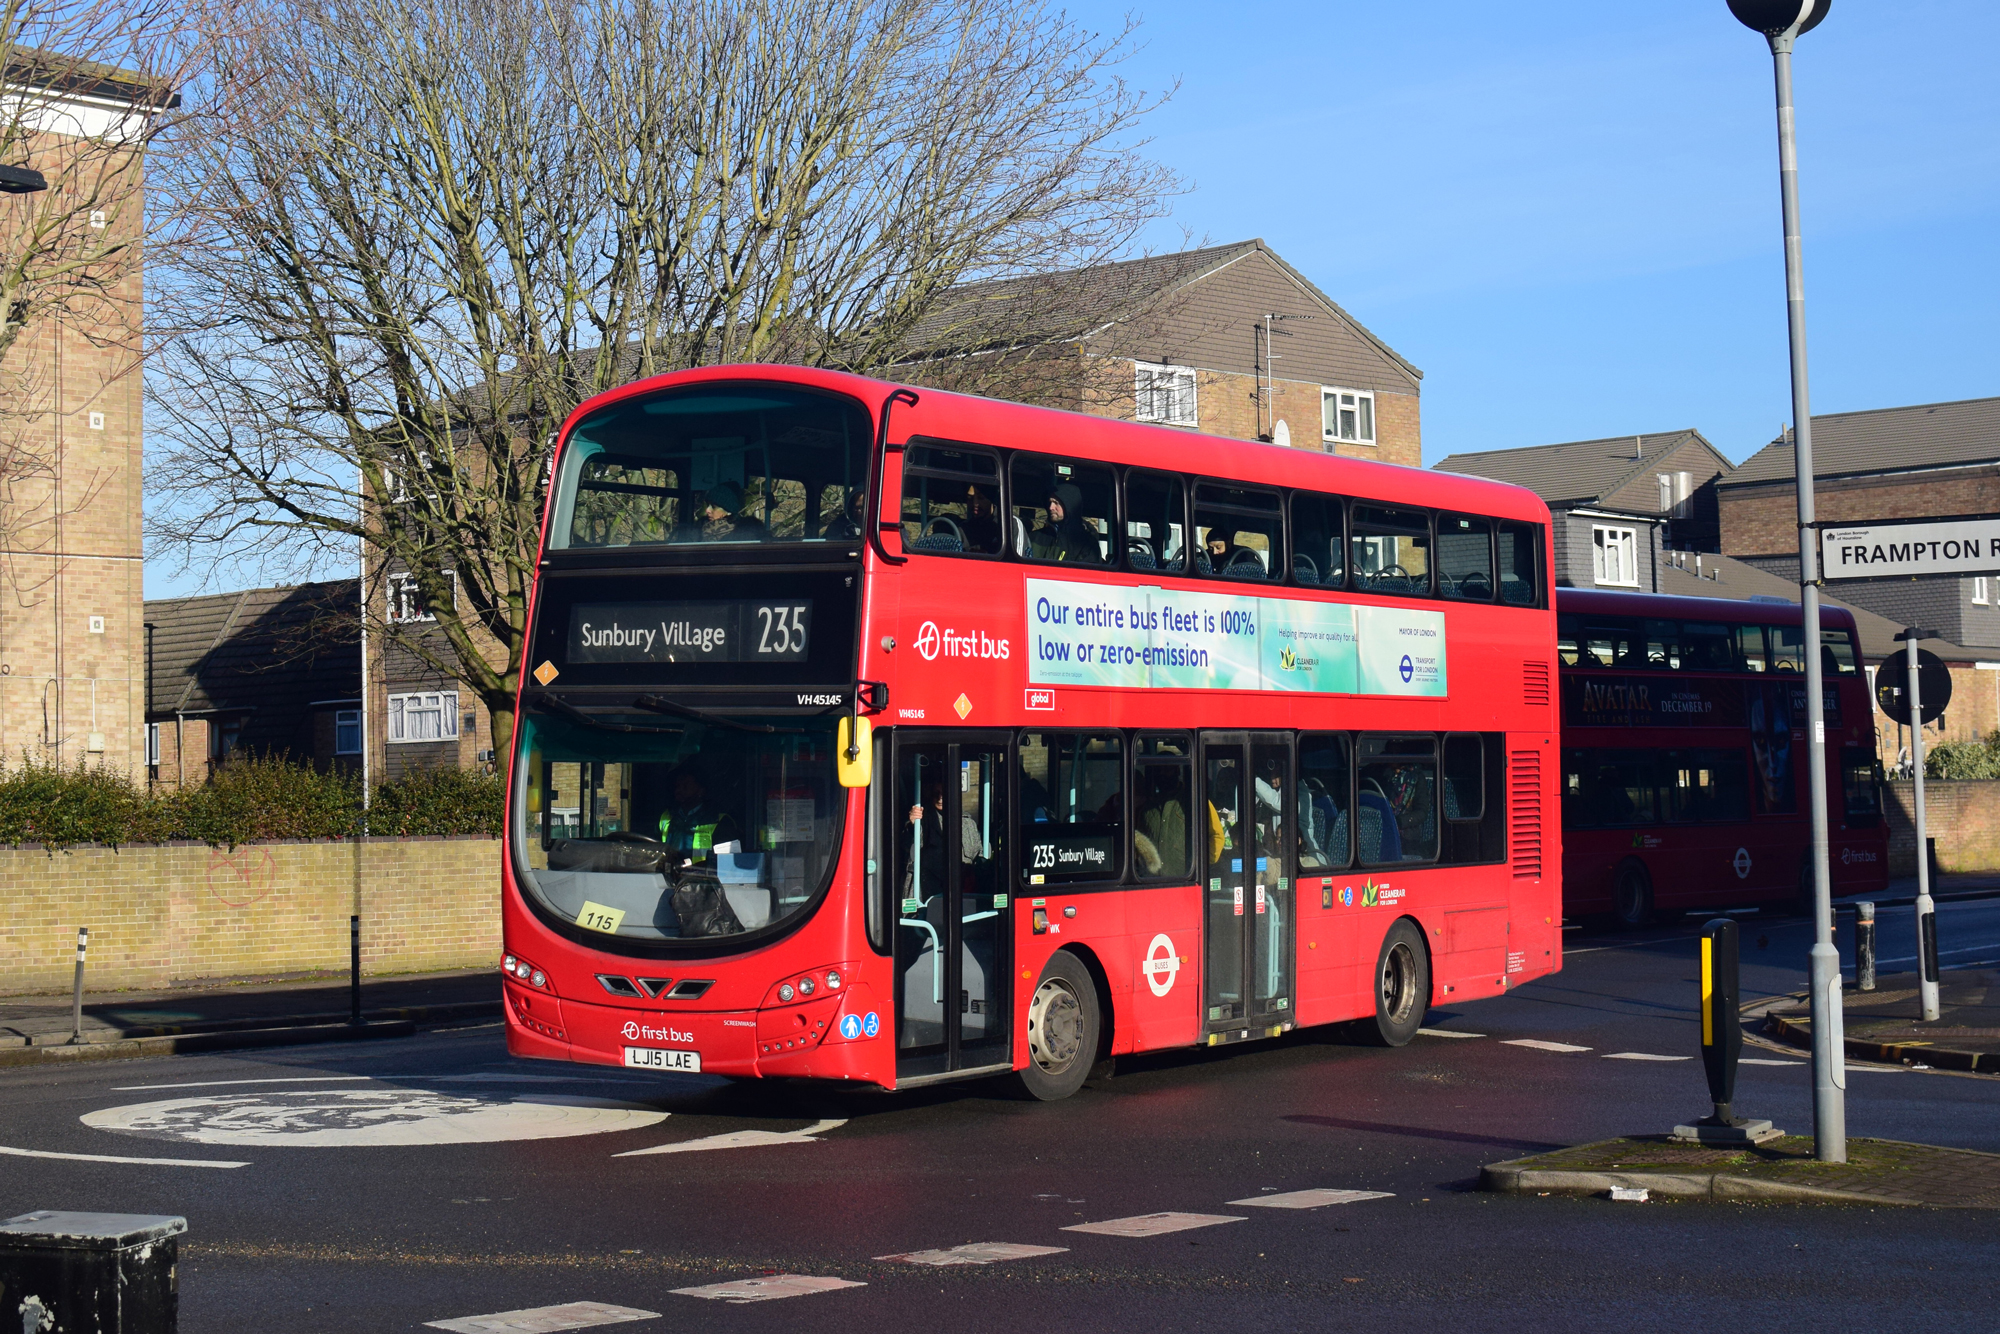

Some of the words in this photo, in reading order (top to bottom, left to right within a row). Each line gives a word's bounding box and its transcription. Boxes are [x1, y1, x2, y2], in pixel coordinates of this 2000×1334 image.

[1841, 539, 1980, 565] FRAMPTON
[1037, 597, 1069, 625] Our
[1075, 602, 1124, 628] entire
[1130, 604, 1158, 631] bus
[1163, 605, 1198, 634] fleet
[1204, 609, 1215, 634] is
[1220, 610, 1255, 636] 100%
[582, 622, 656, 653] Sunbury
[662, 621, 725, 653] Village
[757, 606, 806, 653] 235
[1279, 628, 1298, 641] Helping
[1298, 630, 1318, 641] improve
[1326, 632, 1342, 643] quality
[1343, 633, 1351, 642] for
[943, 629, 978, 658] first
[981, 630, 1010, 660] bus
[1038, 635, 1070, 661] low
[1077, 643, 1094, 663] or
[1099, 643, 1209, 667] zero-emission
[797, 694, 842, 706] VH45145
[1031, 692, 1049, 706] global
[1582, 680, 1653, 712] AVATAR
[1679, 692, 1701, 700] CINEMAS
[899, 708, 925, 719] VH45145
[1661, 700, 1703, 713] DECEMBER
[1705, 701, 1713, 712] 19
[1033, 844, 1055, 868] 235
[1058, 848, 1084, 865] Sunbury
[1084, 847, 1105, 864] Village
[1851, 850, 1865, 862] first
[1865, 850, 1877, 862] bus
[585, 911, 614, 931] 115
[1154, 961, 1169, 970] BUSES
[723, 1019, 757, 1028] SCREENWASH
[641, 1024, 668, 1042] first
[670, 1027, 694, 1043] bus
[632, 1051, 662, 1067] LJ15
[665, 1053, 692, 1069] LAE
